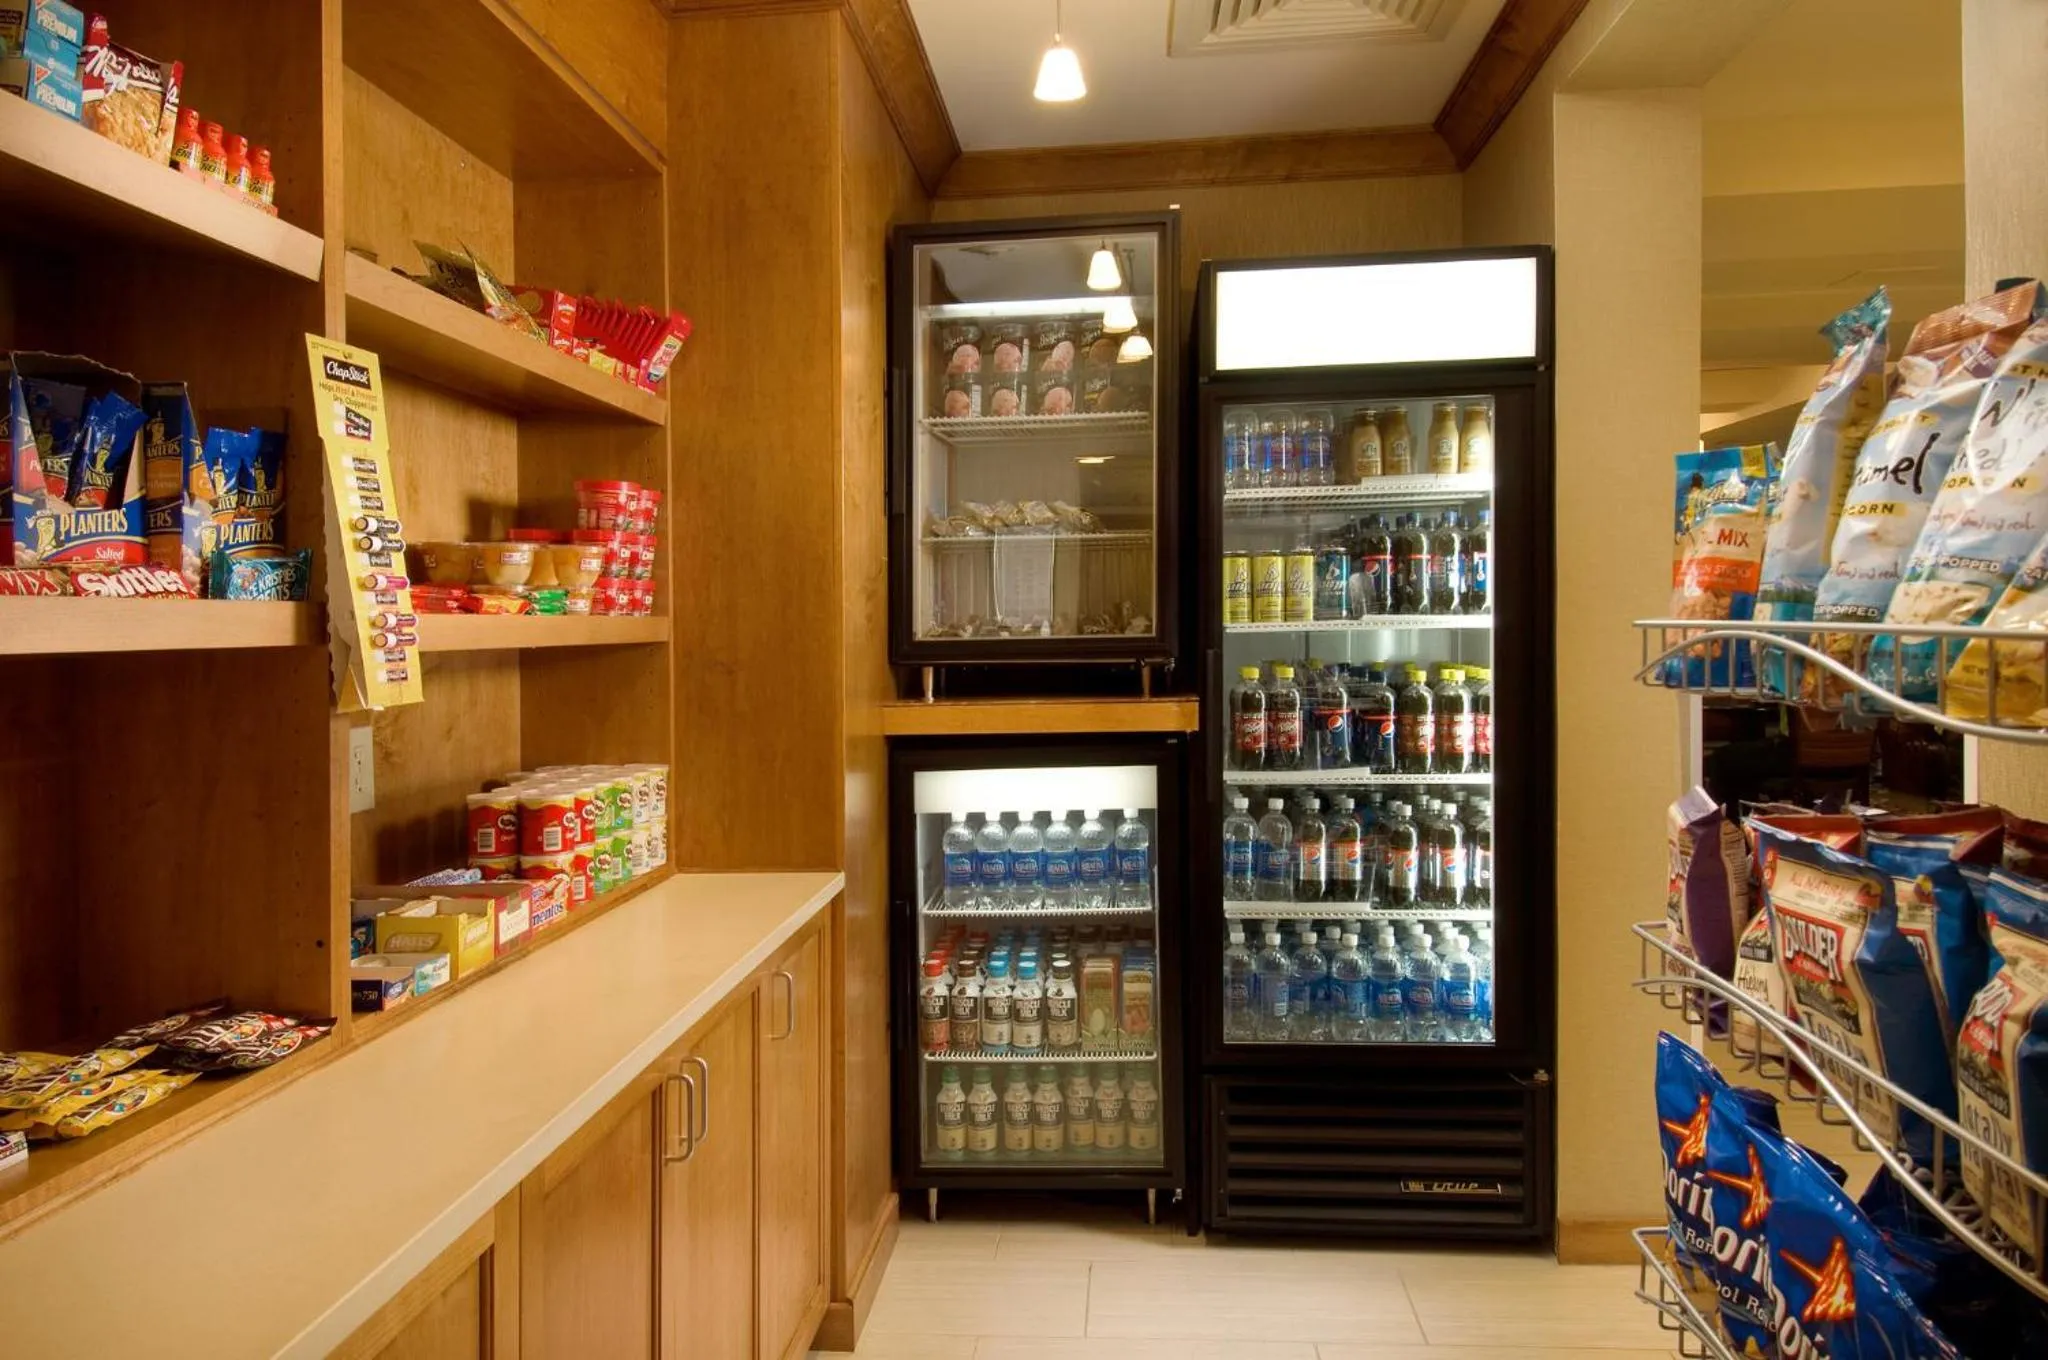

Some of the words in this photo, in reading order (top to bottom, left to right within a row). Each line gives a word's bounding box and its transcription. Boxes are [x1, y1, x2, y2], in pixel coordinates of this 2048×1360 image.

[59, 507, 129, 541] PLANTERS
[219, 519, 275, 549] PLANTERS
[1716, 528, 1749, 547] MIX
[95, 547, 125, 561] Salted
[78, 566, 189, 599] Skittles
[532, 902, 565, 927] mentos
[390, 934, 435, 949] HALLS
[1684, 1227, 1713, 1255] Ran
